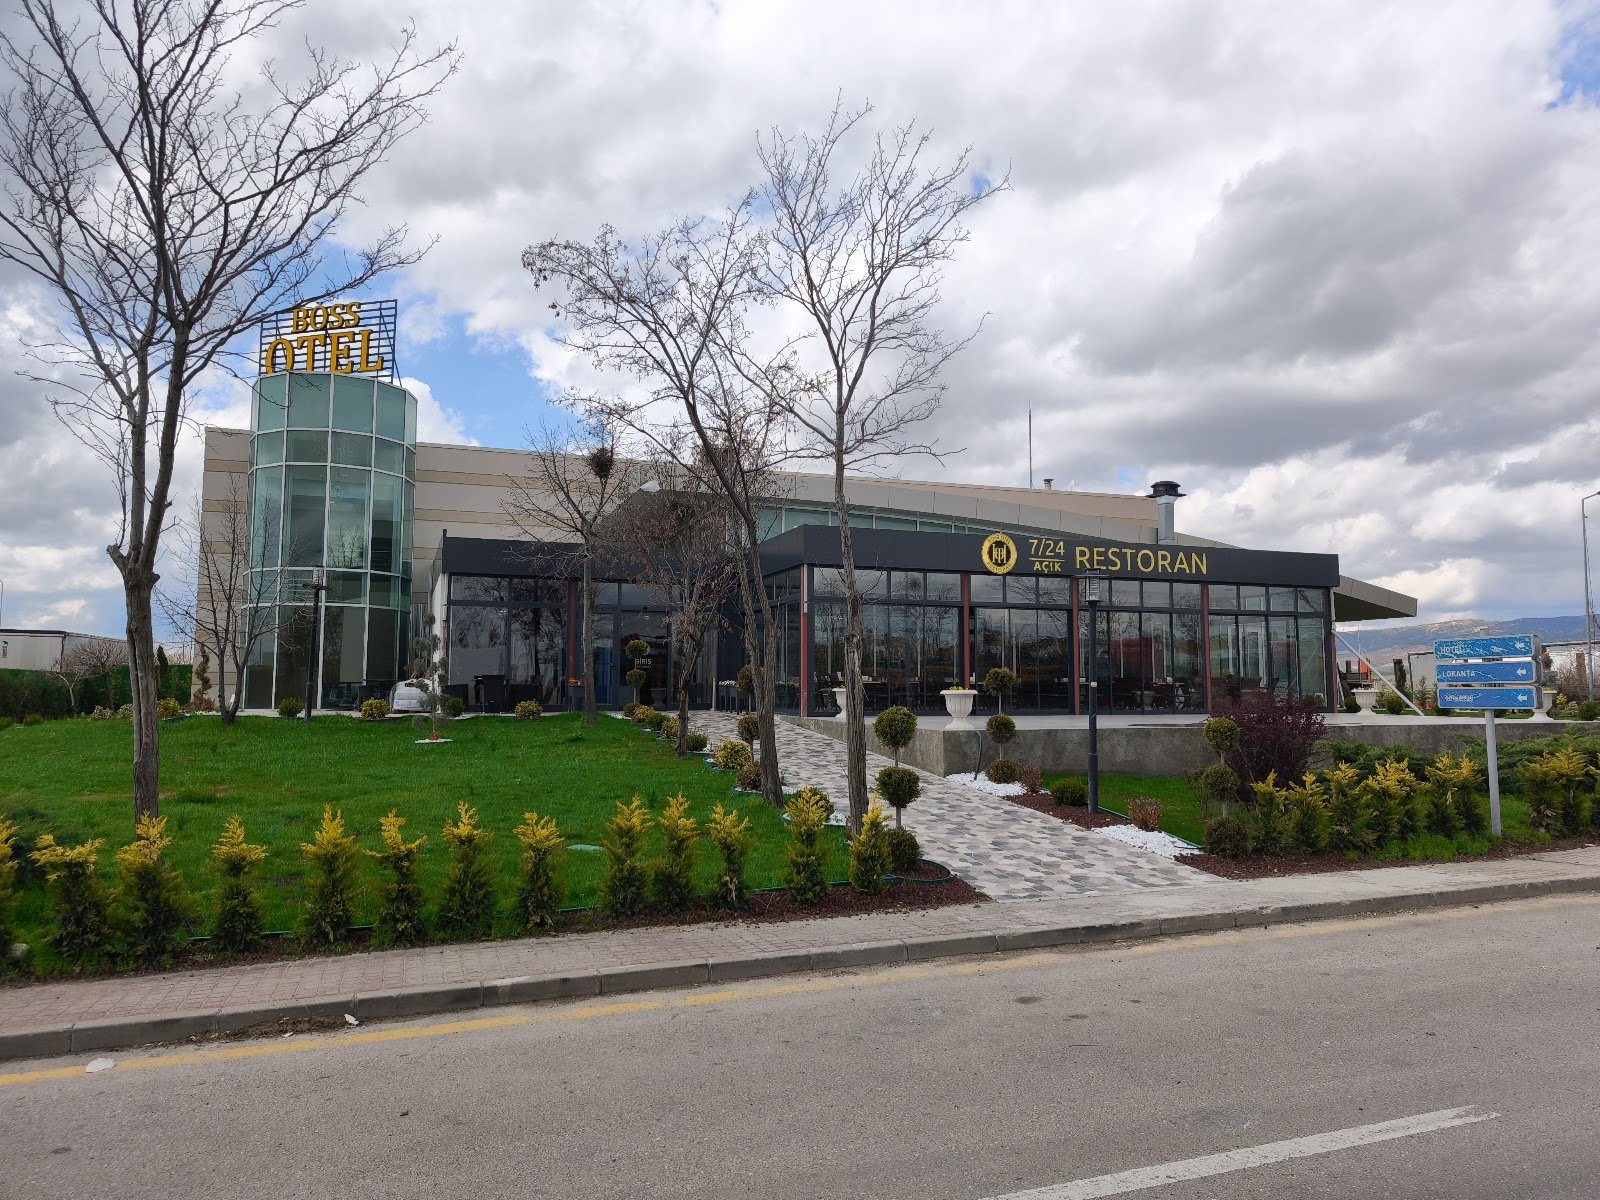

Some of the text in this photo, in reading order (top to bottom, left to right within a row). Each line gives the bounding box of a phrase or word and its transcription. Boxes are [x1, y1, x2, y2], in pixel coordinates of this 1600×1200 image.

[292, 302, 361, 333] BOSS
[265, 329, 384, 375] OTEL
[1029, 539, 1065, 556] 7/24
[1033, 560, 1062, 573] AÇIK
[1075, 546, 1208, 575] RESTORAN
[1442, 669, 1476, 678] LOKANTA
